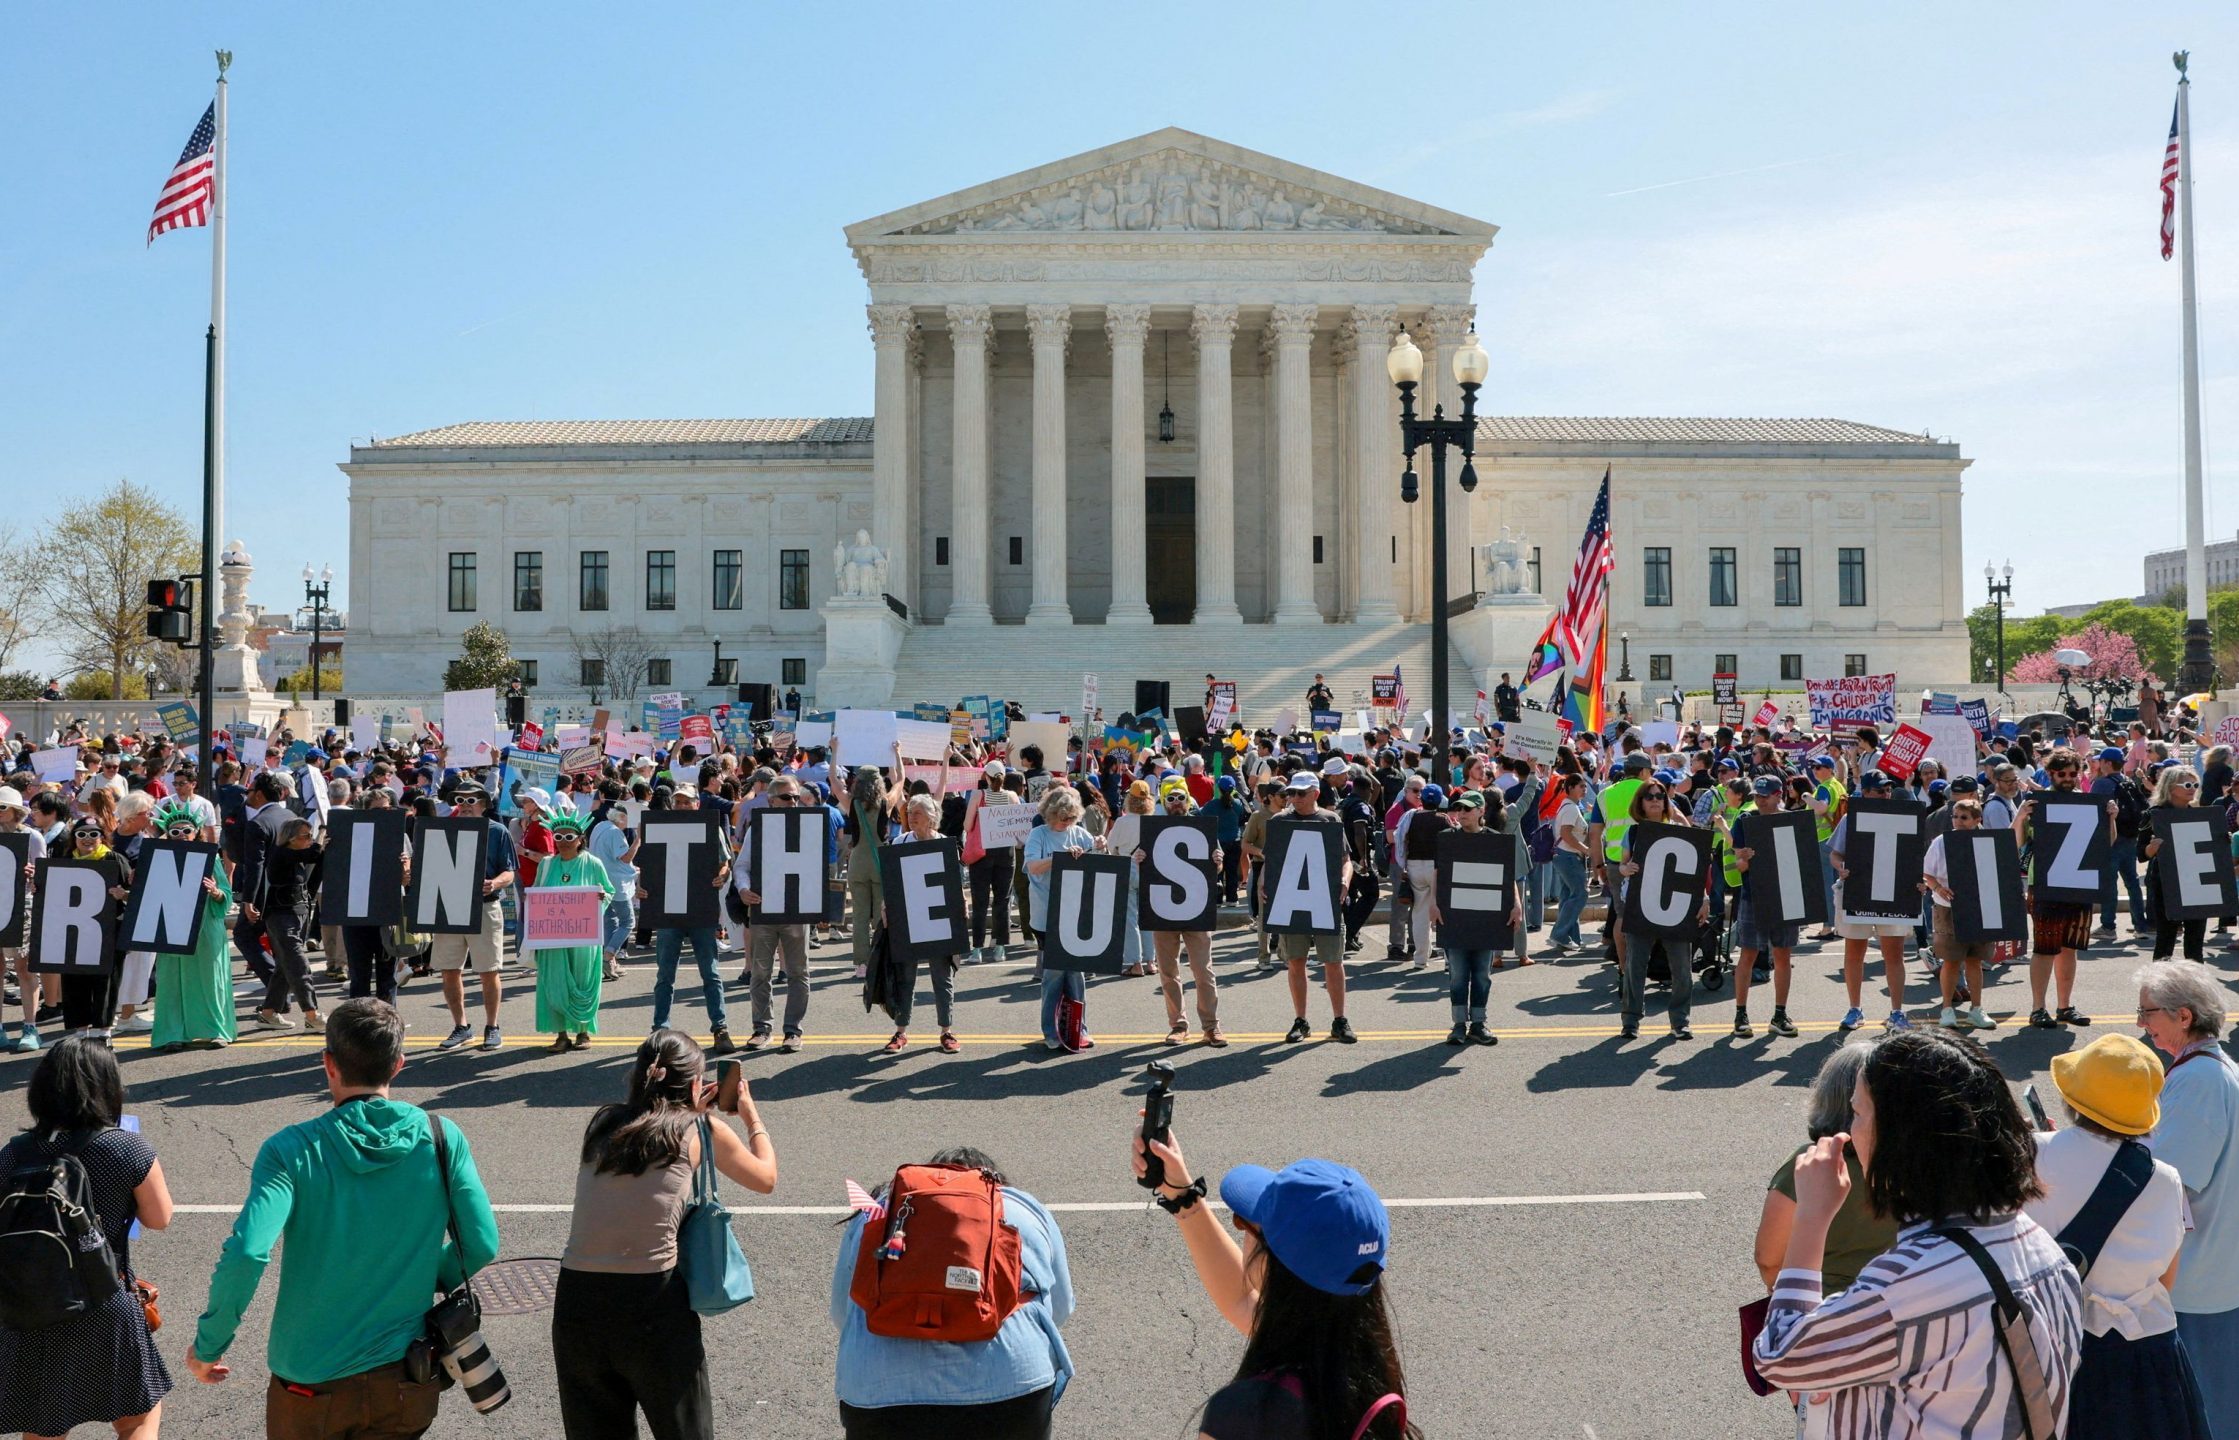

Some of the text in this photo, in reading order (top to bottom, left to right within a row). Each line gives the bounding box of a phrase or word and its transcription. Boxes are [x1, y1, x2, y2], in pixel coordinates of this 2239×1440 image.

[1969, 716, 1988, 728] GHT
[1894, 734, 1925, 755] BIRTH
[1888, 743, 1920, 765] RIGHT
[530, 892, 586, 905] CITIZENSHIP
[547, 908, 555, 916] IS
[529, 917, 592, 935] BIRTHRIGHT
